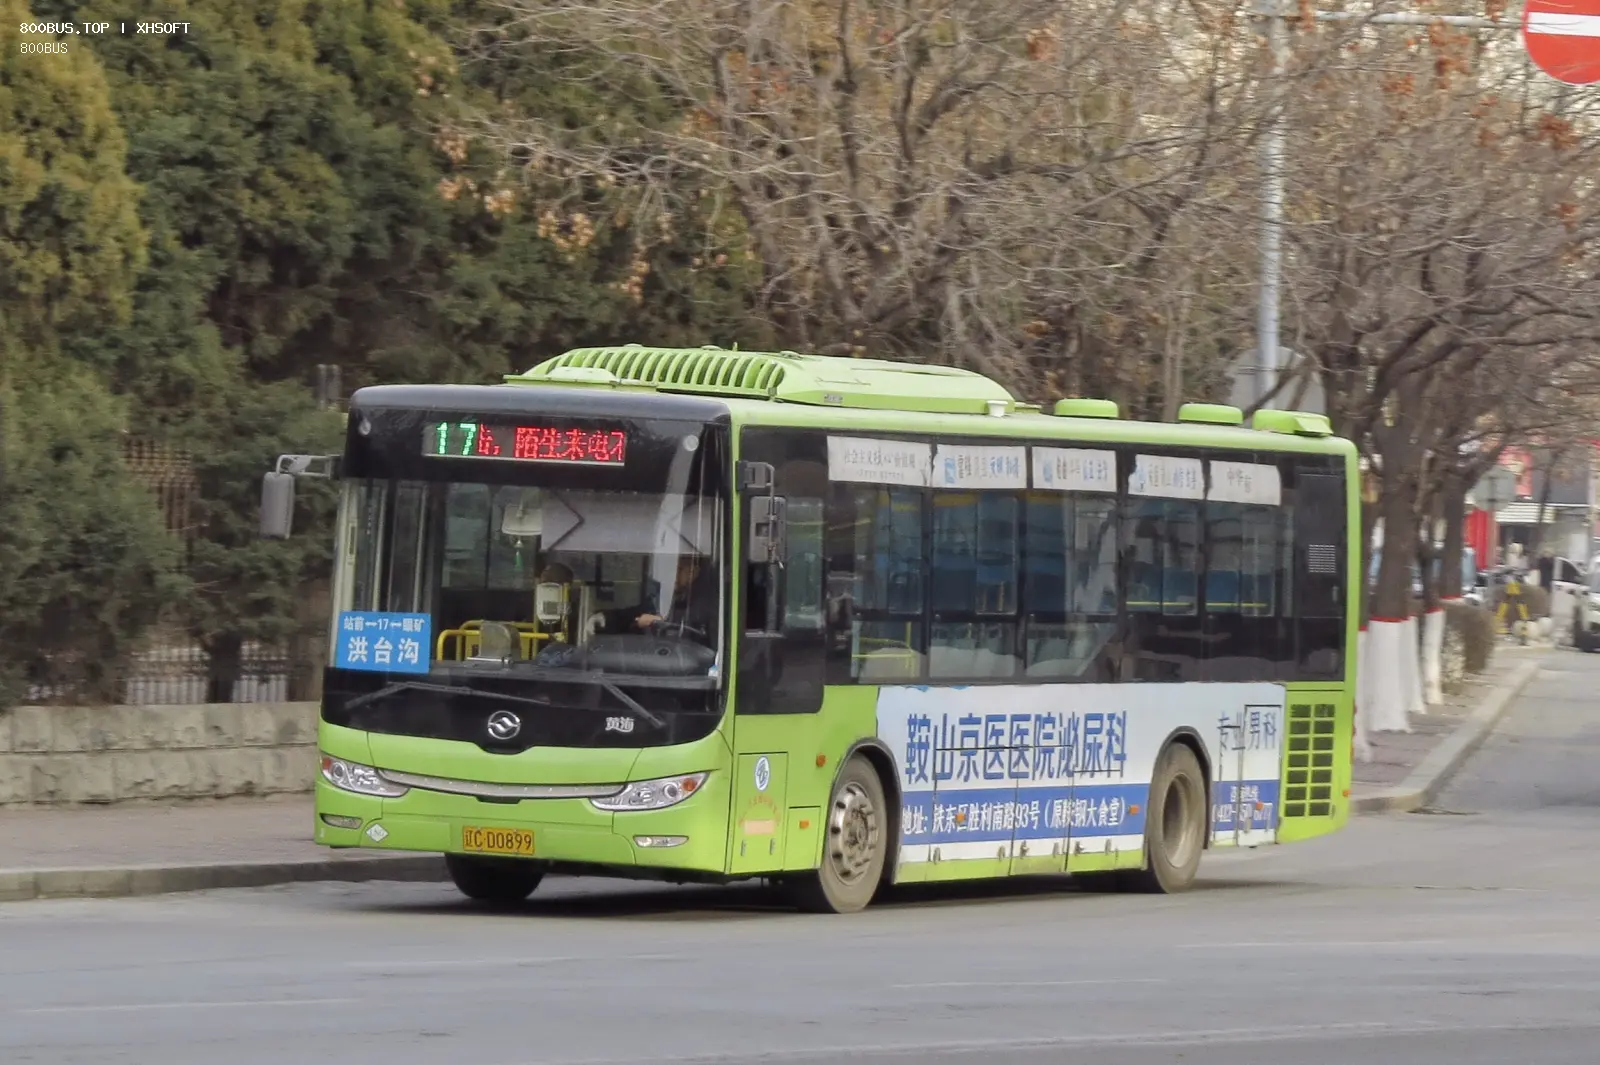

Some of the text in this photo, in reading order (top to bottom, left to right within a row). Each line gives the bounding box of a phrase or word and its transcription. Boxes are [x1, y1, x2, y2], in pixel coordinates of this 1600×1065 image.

[347, 636, 419, 665] 洪台沟
[604, 716, 635, 733] 黄海
[905, 710, 1128, 785] 鞍山京医医院泌尿科
